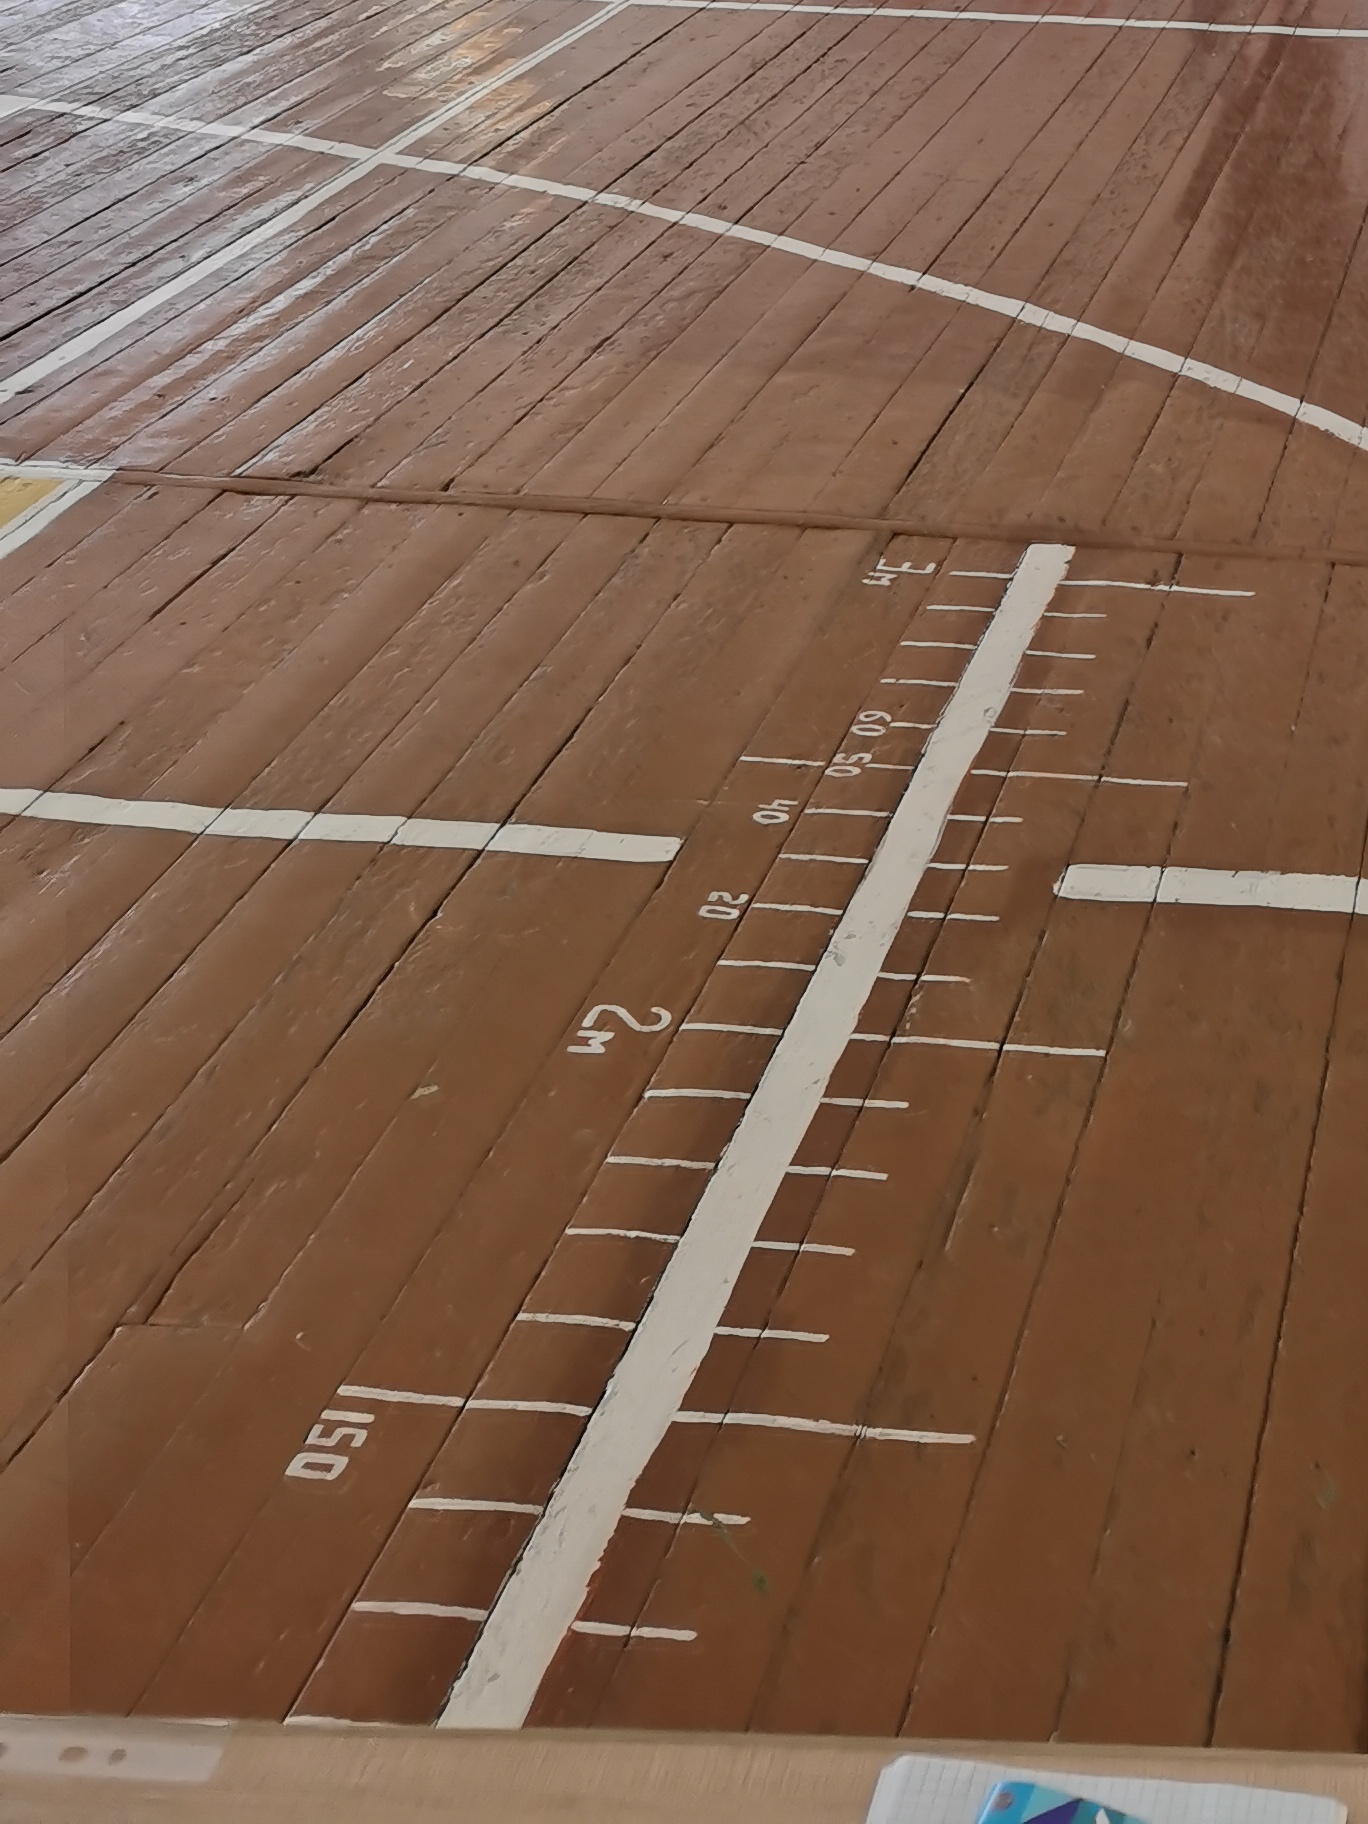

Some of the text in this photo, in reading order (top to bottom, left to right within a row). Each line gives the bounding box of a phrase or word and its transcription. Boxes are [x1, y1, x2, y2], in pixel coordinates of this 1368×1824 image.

[850, 710, 892, 737] 60
[824, 752, 873, 778] 50
[752, 798, 799, 825] 40
[699, 891, 750, 920] 20
[284, 1409, 375, 1481] 150
